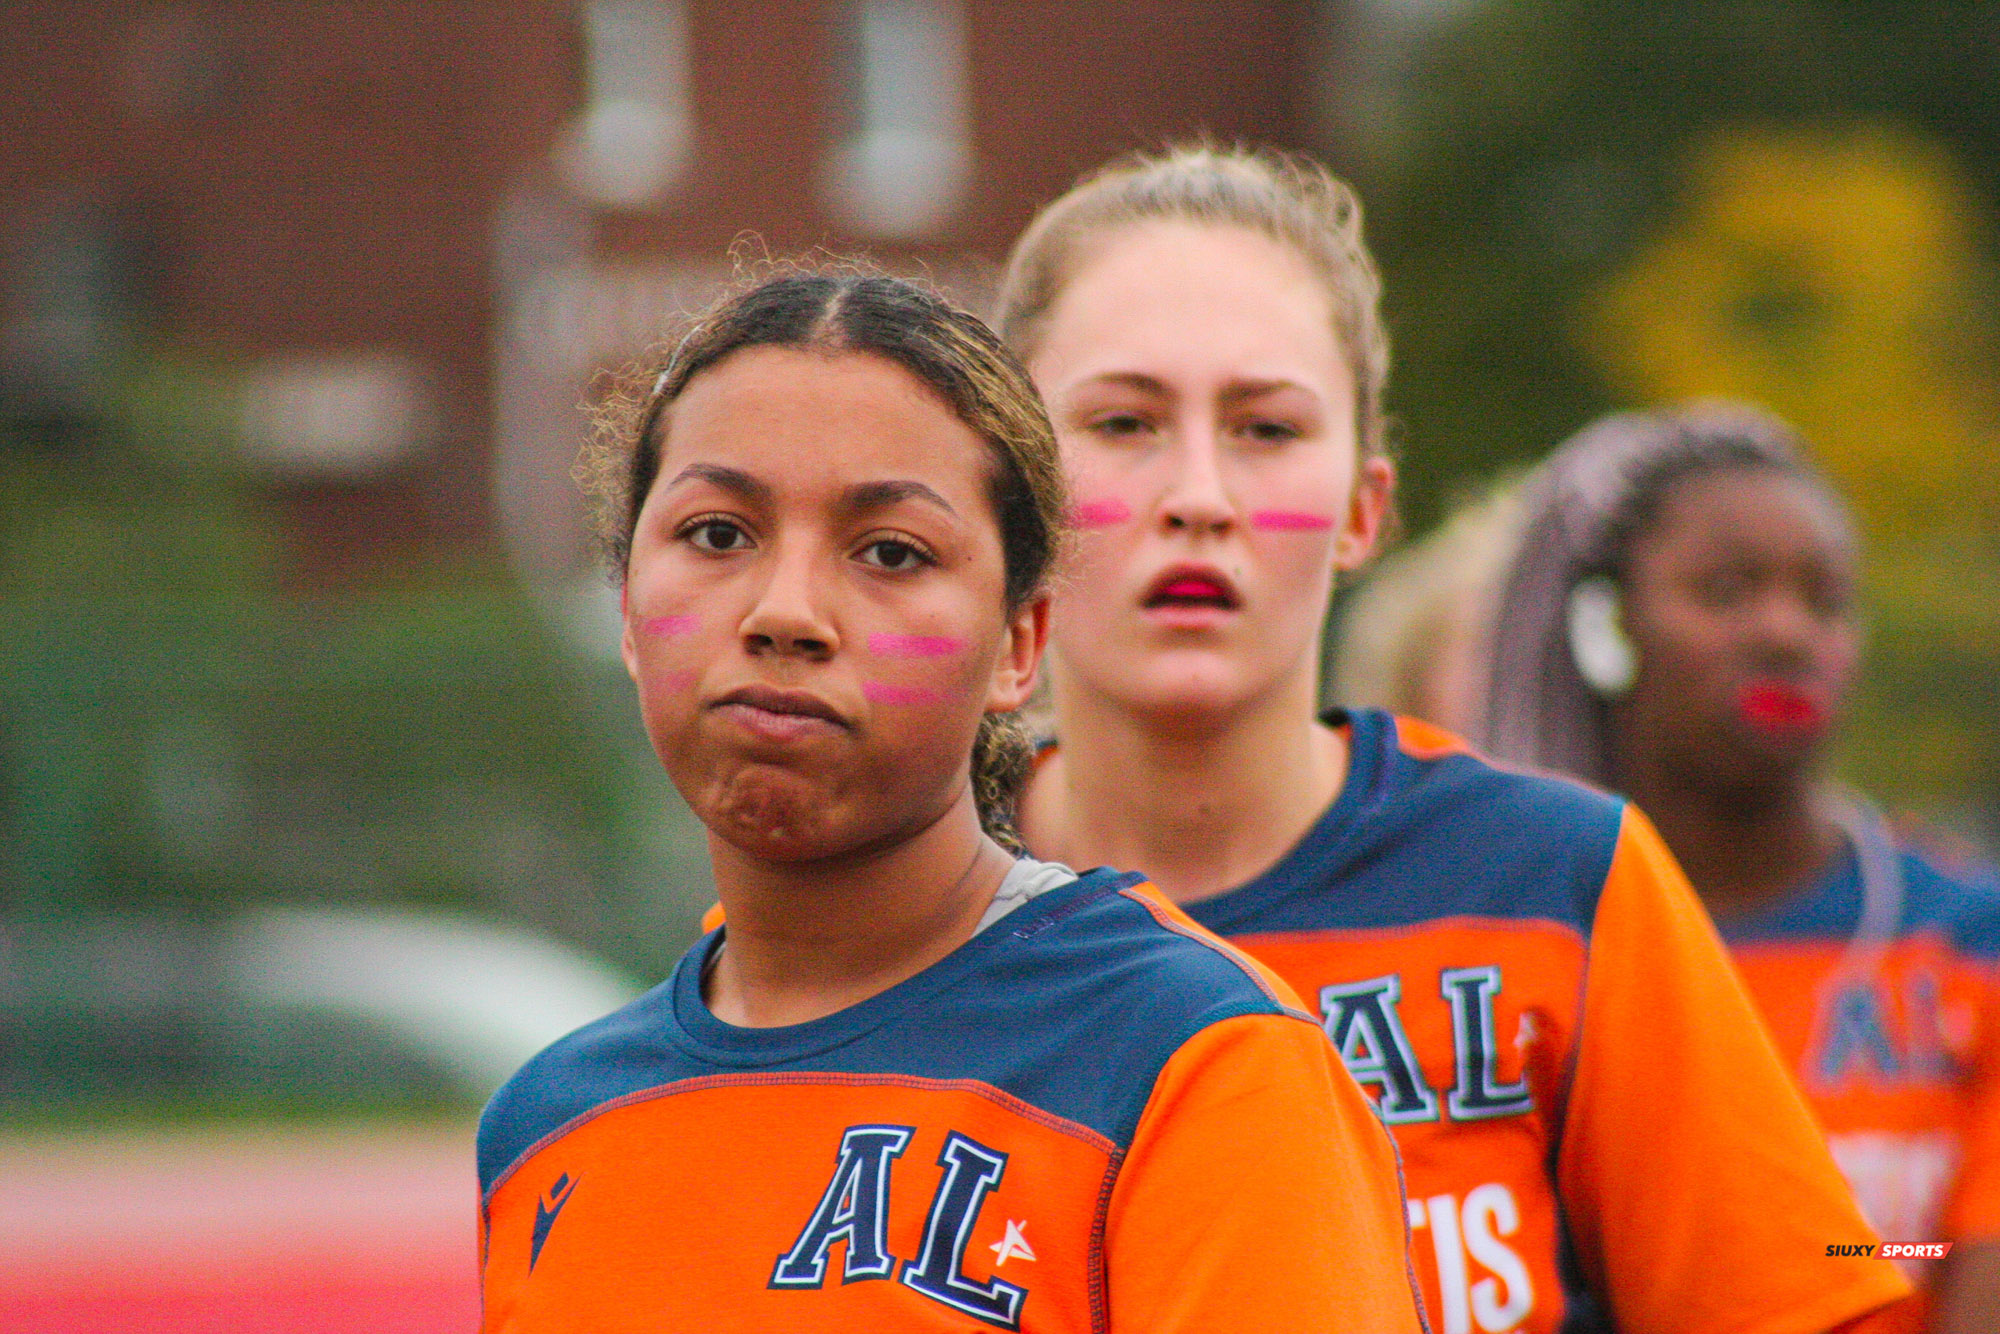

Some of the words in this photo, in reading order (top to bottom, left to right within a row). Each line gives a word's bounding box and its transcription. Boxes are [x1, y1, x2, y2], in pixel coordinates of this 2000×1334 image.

[1319, 964, 1533, 1124] AL
[767, 1124, 1029, 1333] AL
[1408, 1183, 1533, 1334] IS
